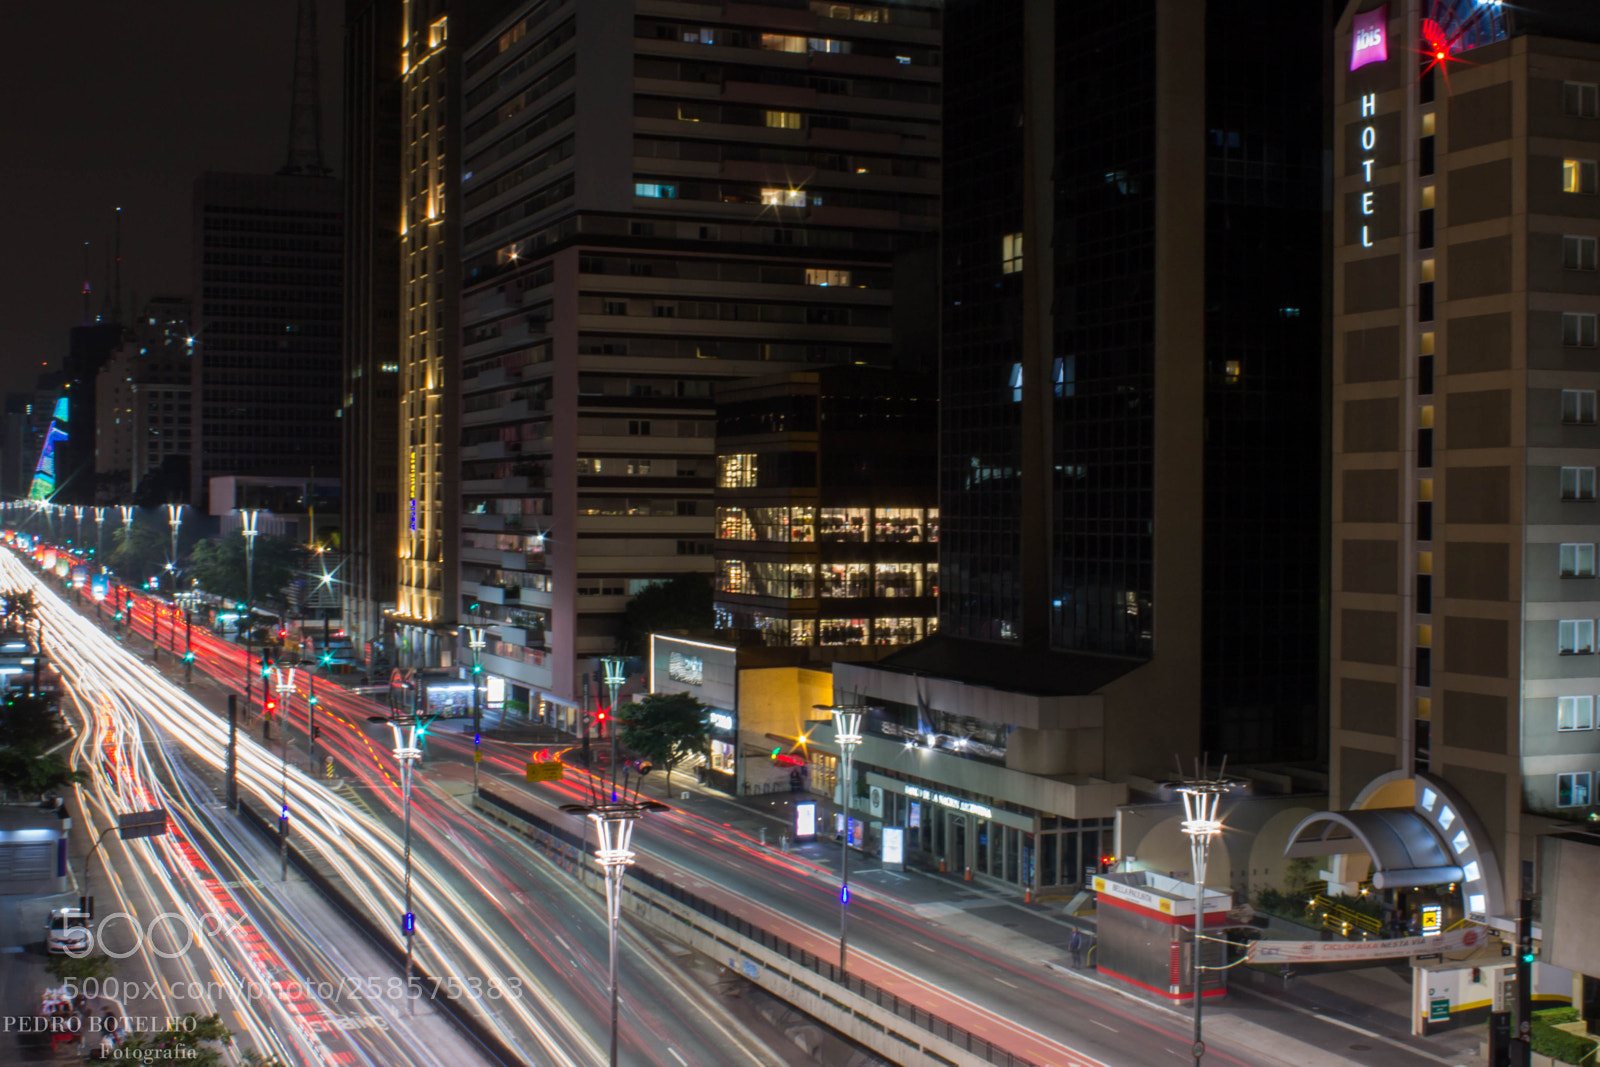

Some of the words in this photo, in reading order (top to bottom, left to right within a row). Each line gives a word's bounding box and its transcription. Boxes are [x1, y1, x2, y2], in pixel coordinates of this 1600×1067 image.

[1355, 27, 1382, 51] ibis
[1361, 92, 1376, 248] HOTEL
[1322, 942, 1378, 951] CICLOFAIXA
[1380, 939, 1409, 949] NESTA
[1411, 937, 1426, 946] VIA
